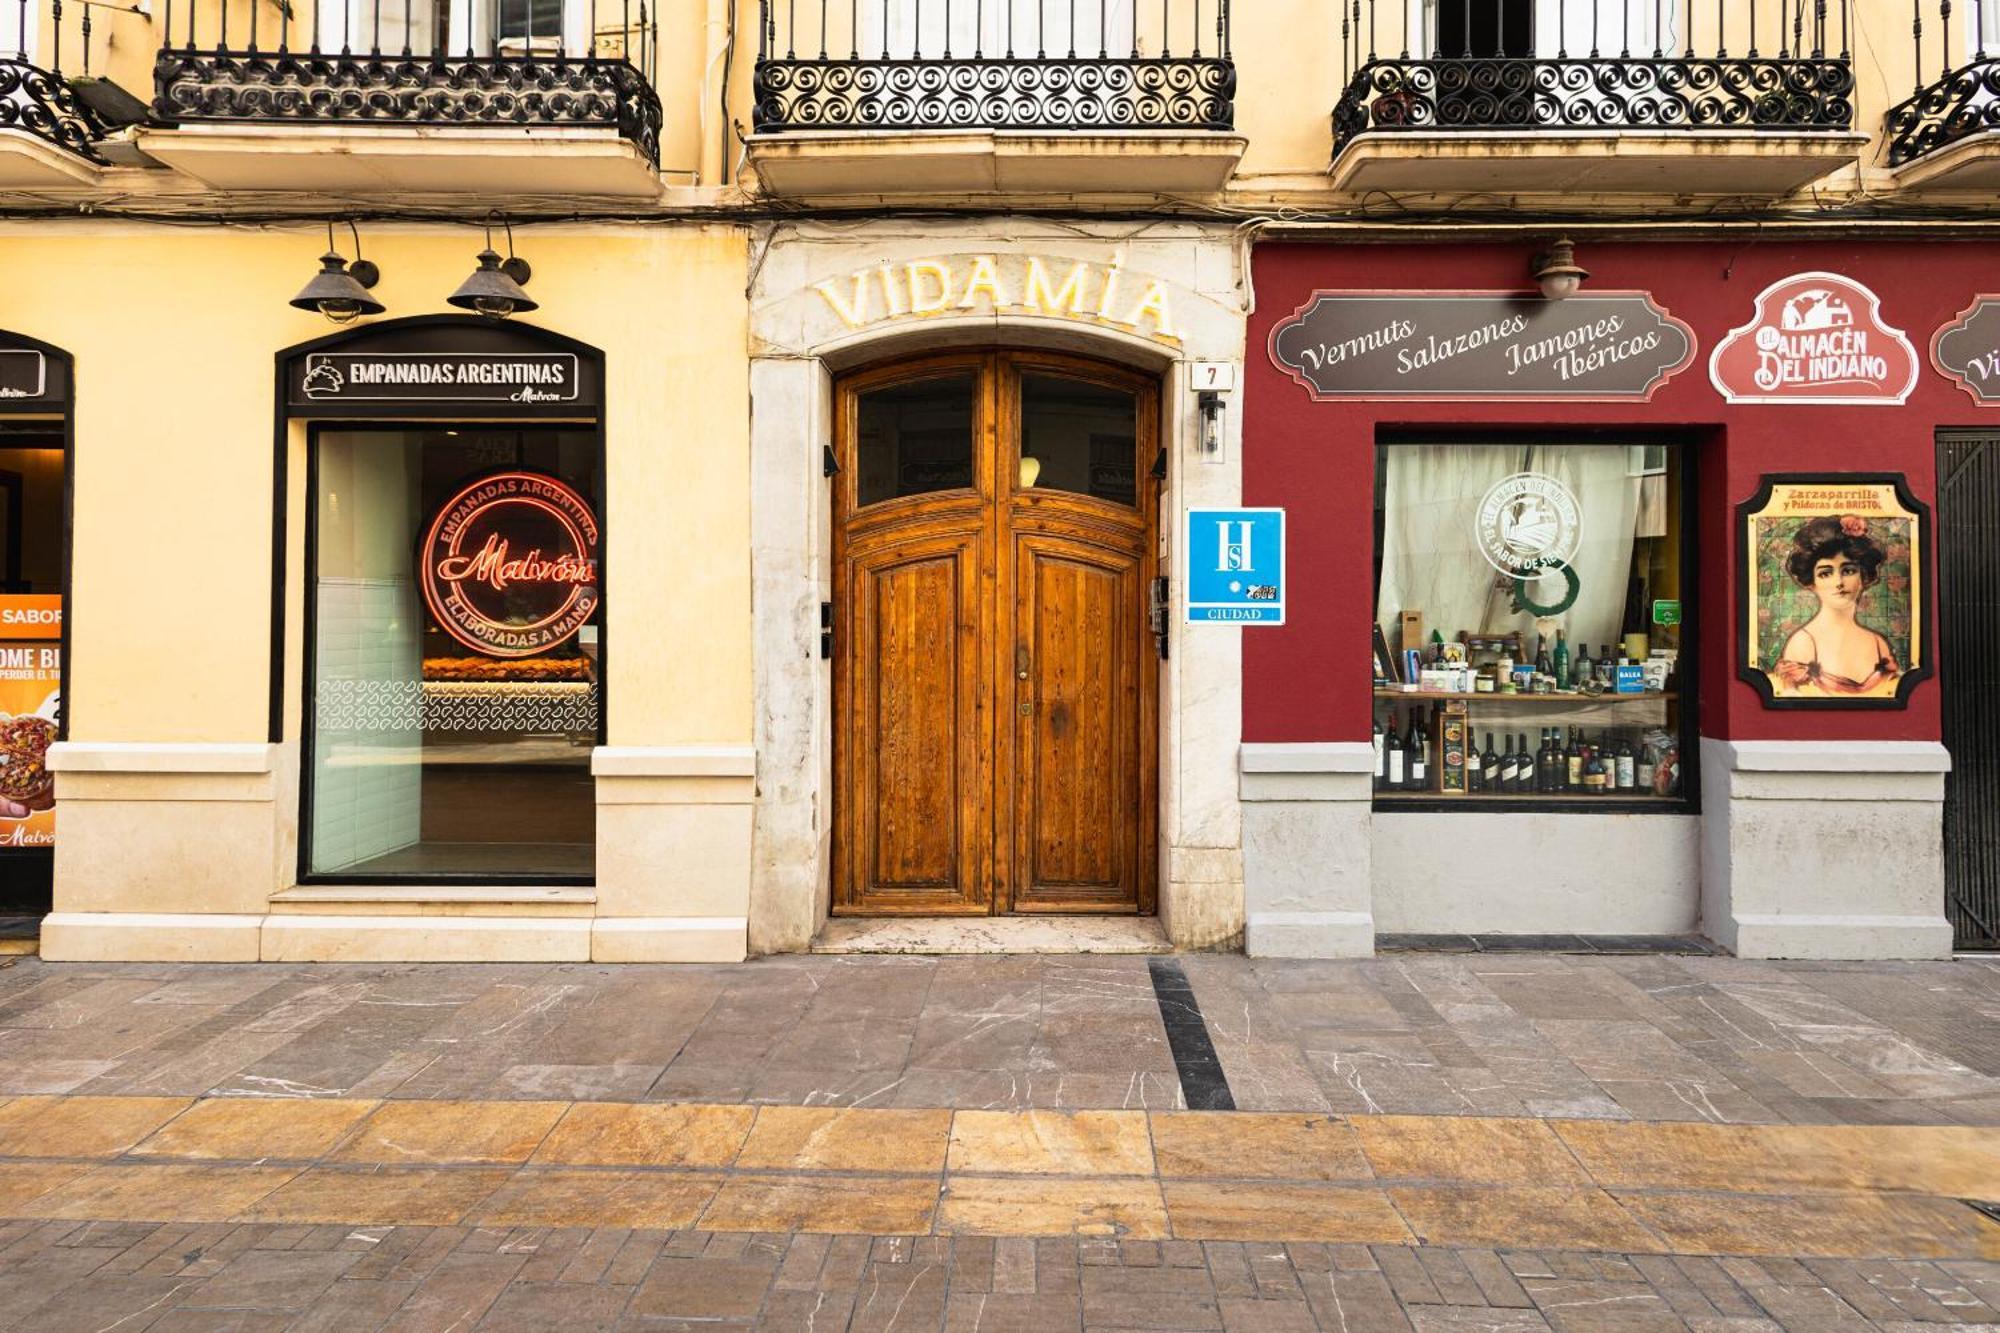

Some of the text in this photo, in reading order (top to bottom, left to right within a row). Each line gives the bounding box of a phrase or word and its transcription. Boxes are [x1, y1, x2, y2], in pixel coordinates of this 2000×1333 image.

[1301, 319, 1417, 371] Vermuts
[1397, 313, 1529, 374] Salazones
[1505, 315, 1624, 375] Jamones
[1553, 331, 1661, 381] Ibéricos
[350, 363, 564, 384] EMPANADAS ARGENTINAS
[1207, 368, 1217, 386] 7
[1755, 350, 1887, 391] DEL INDIANO
[441, 480, 517, 544] EMPANADAS
[1784, 502, 1790, 512] y
[1833, 501, 1844, 509] de
[1788, 488, 1880, 500] Zarzaparrilla
[437, 532, 596, 590] Malvón
[1489, 542, 1521, 569] SABOR
[1524, 558, 1538, 570] DE
[444, 595, 592, 647] ELABORADAS A MANO
[1207, 609, 1262, 620] CIUDAD
